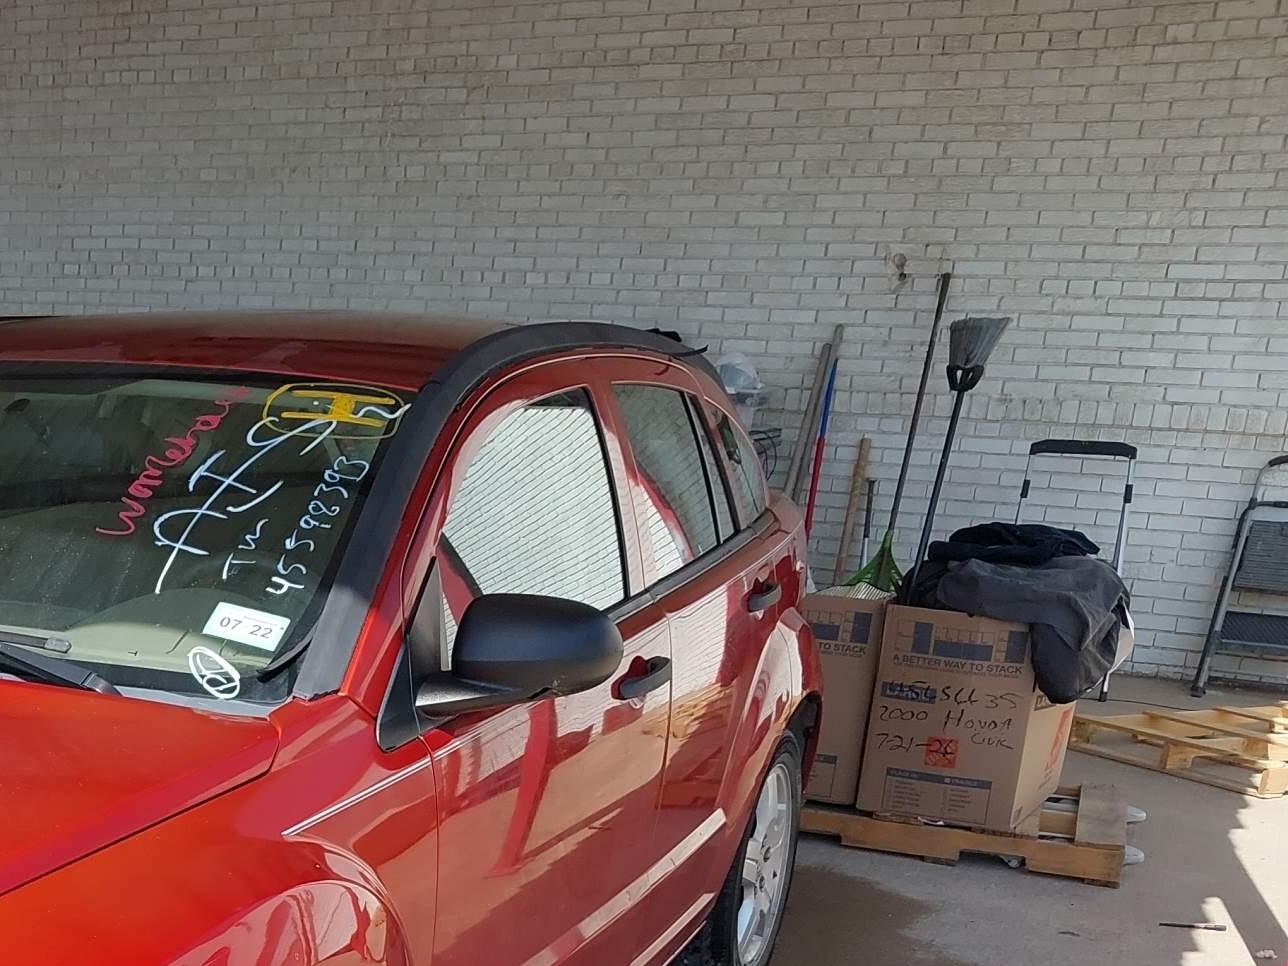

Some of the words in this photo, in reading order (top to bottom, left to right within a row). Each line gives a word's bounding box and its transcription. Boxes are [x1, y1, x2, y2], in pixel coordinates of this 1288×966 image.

[265, 455, 370, 596] 45598393
[219, 616, 243, 631] 07
[249, 624, 273, 639] 22
[833, 643, 867, 655] STACK
[893, 654, 900, 662] A
[903, 655, 941, 667] BETTER
[944, 660, 967, 671] WAY
[969, 663, 984, 672] TO
[986, 664, 1024, 675] STACK
[879, 705, 929, 722] 2000
